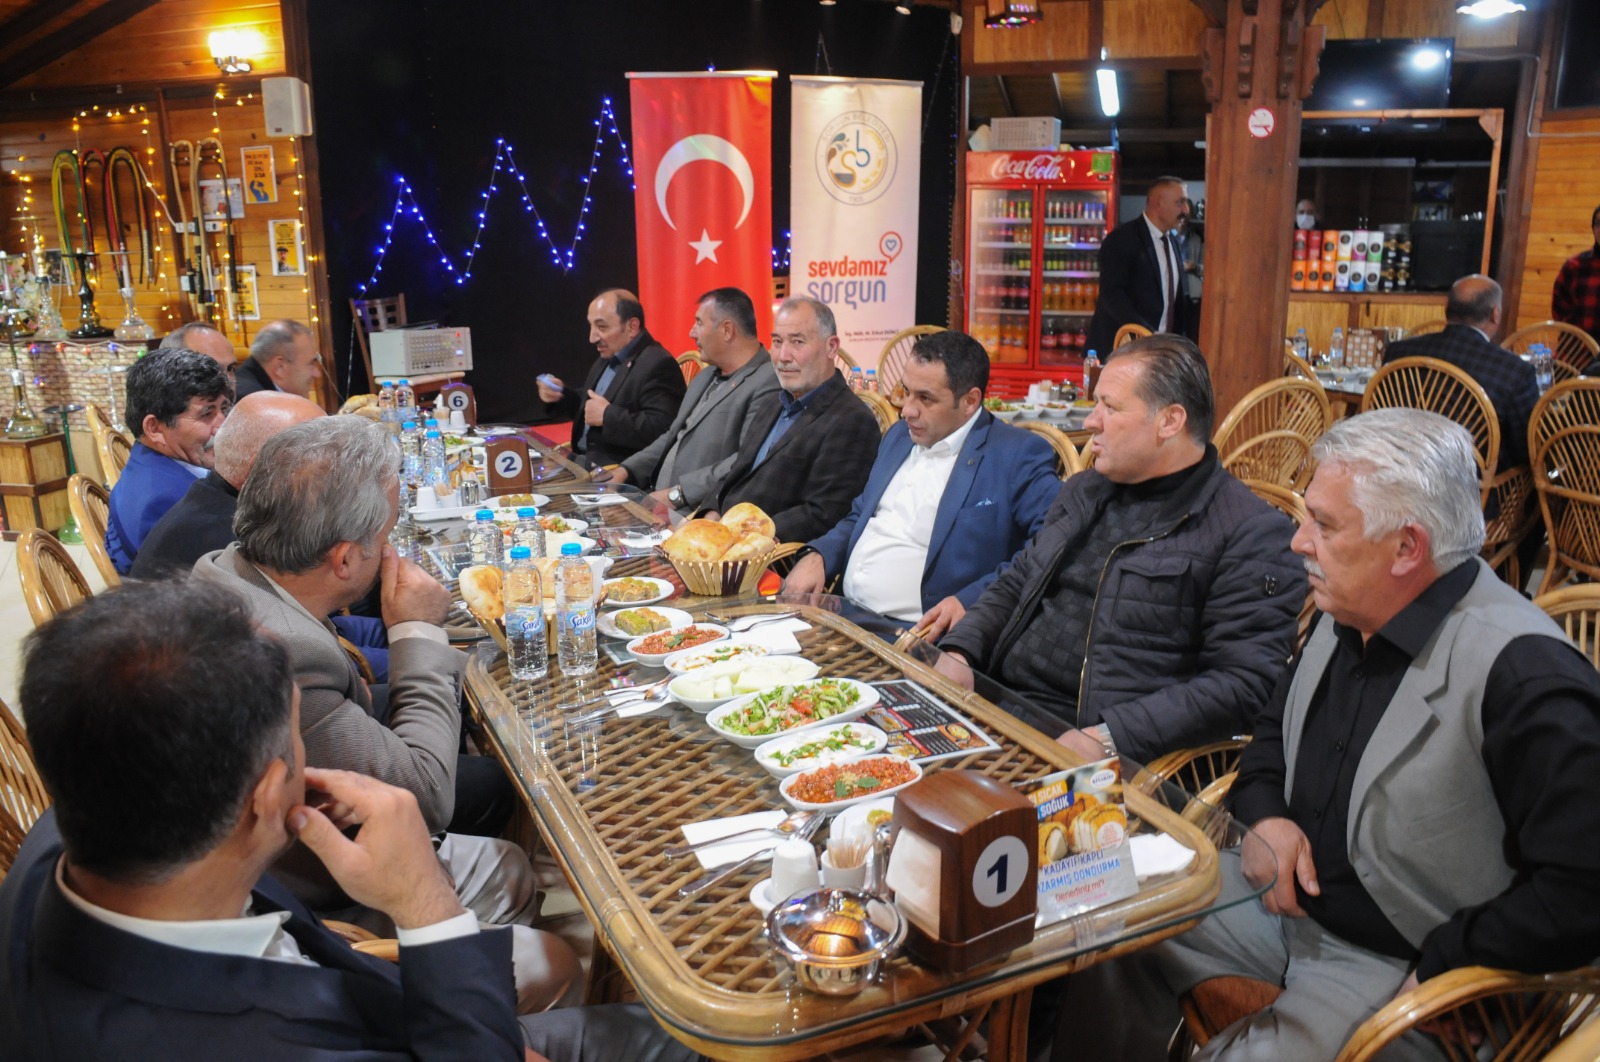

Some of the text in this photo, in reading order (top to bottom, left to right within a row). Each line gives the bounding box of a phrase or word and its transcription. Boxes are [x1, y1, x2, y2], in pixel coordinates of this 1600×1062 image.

[808, 256, 887, 278] sevdamız
[807, 279, 887, 311] sorgun
[452, 395, 464, 408] 6
[501, 456, 517, 473] 2
[571, 615, 592, 630] Saka
[1037, 782, 1063, 802] SICAK
[1040, 795, 1069, 817] SOĞUK
[987, 853, 1008, 895] 1
[1038, 857, 1121, 895] IZARMIŞ DONDURMA
[1043, 855, 1079, 877] KADAYIF
